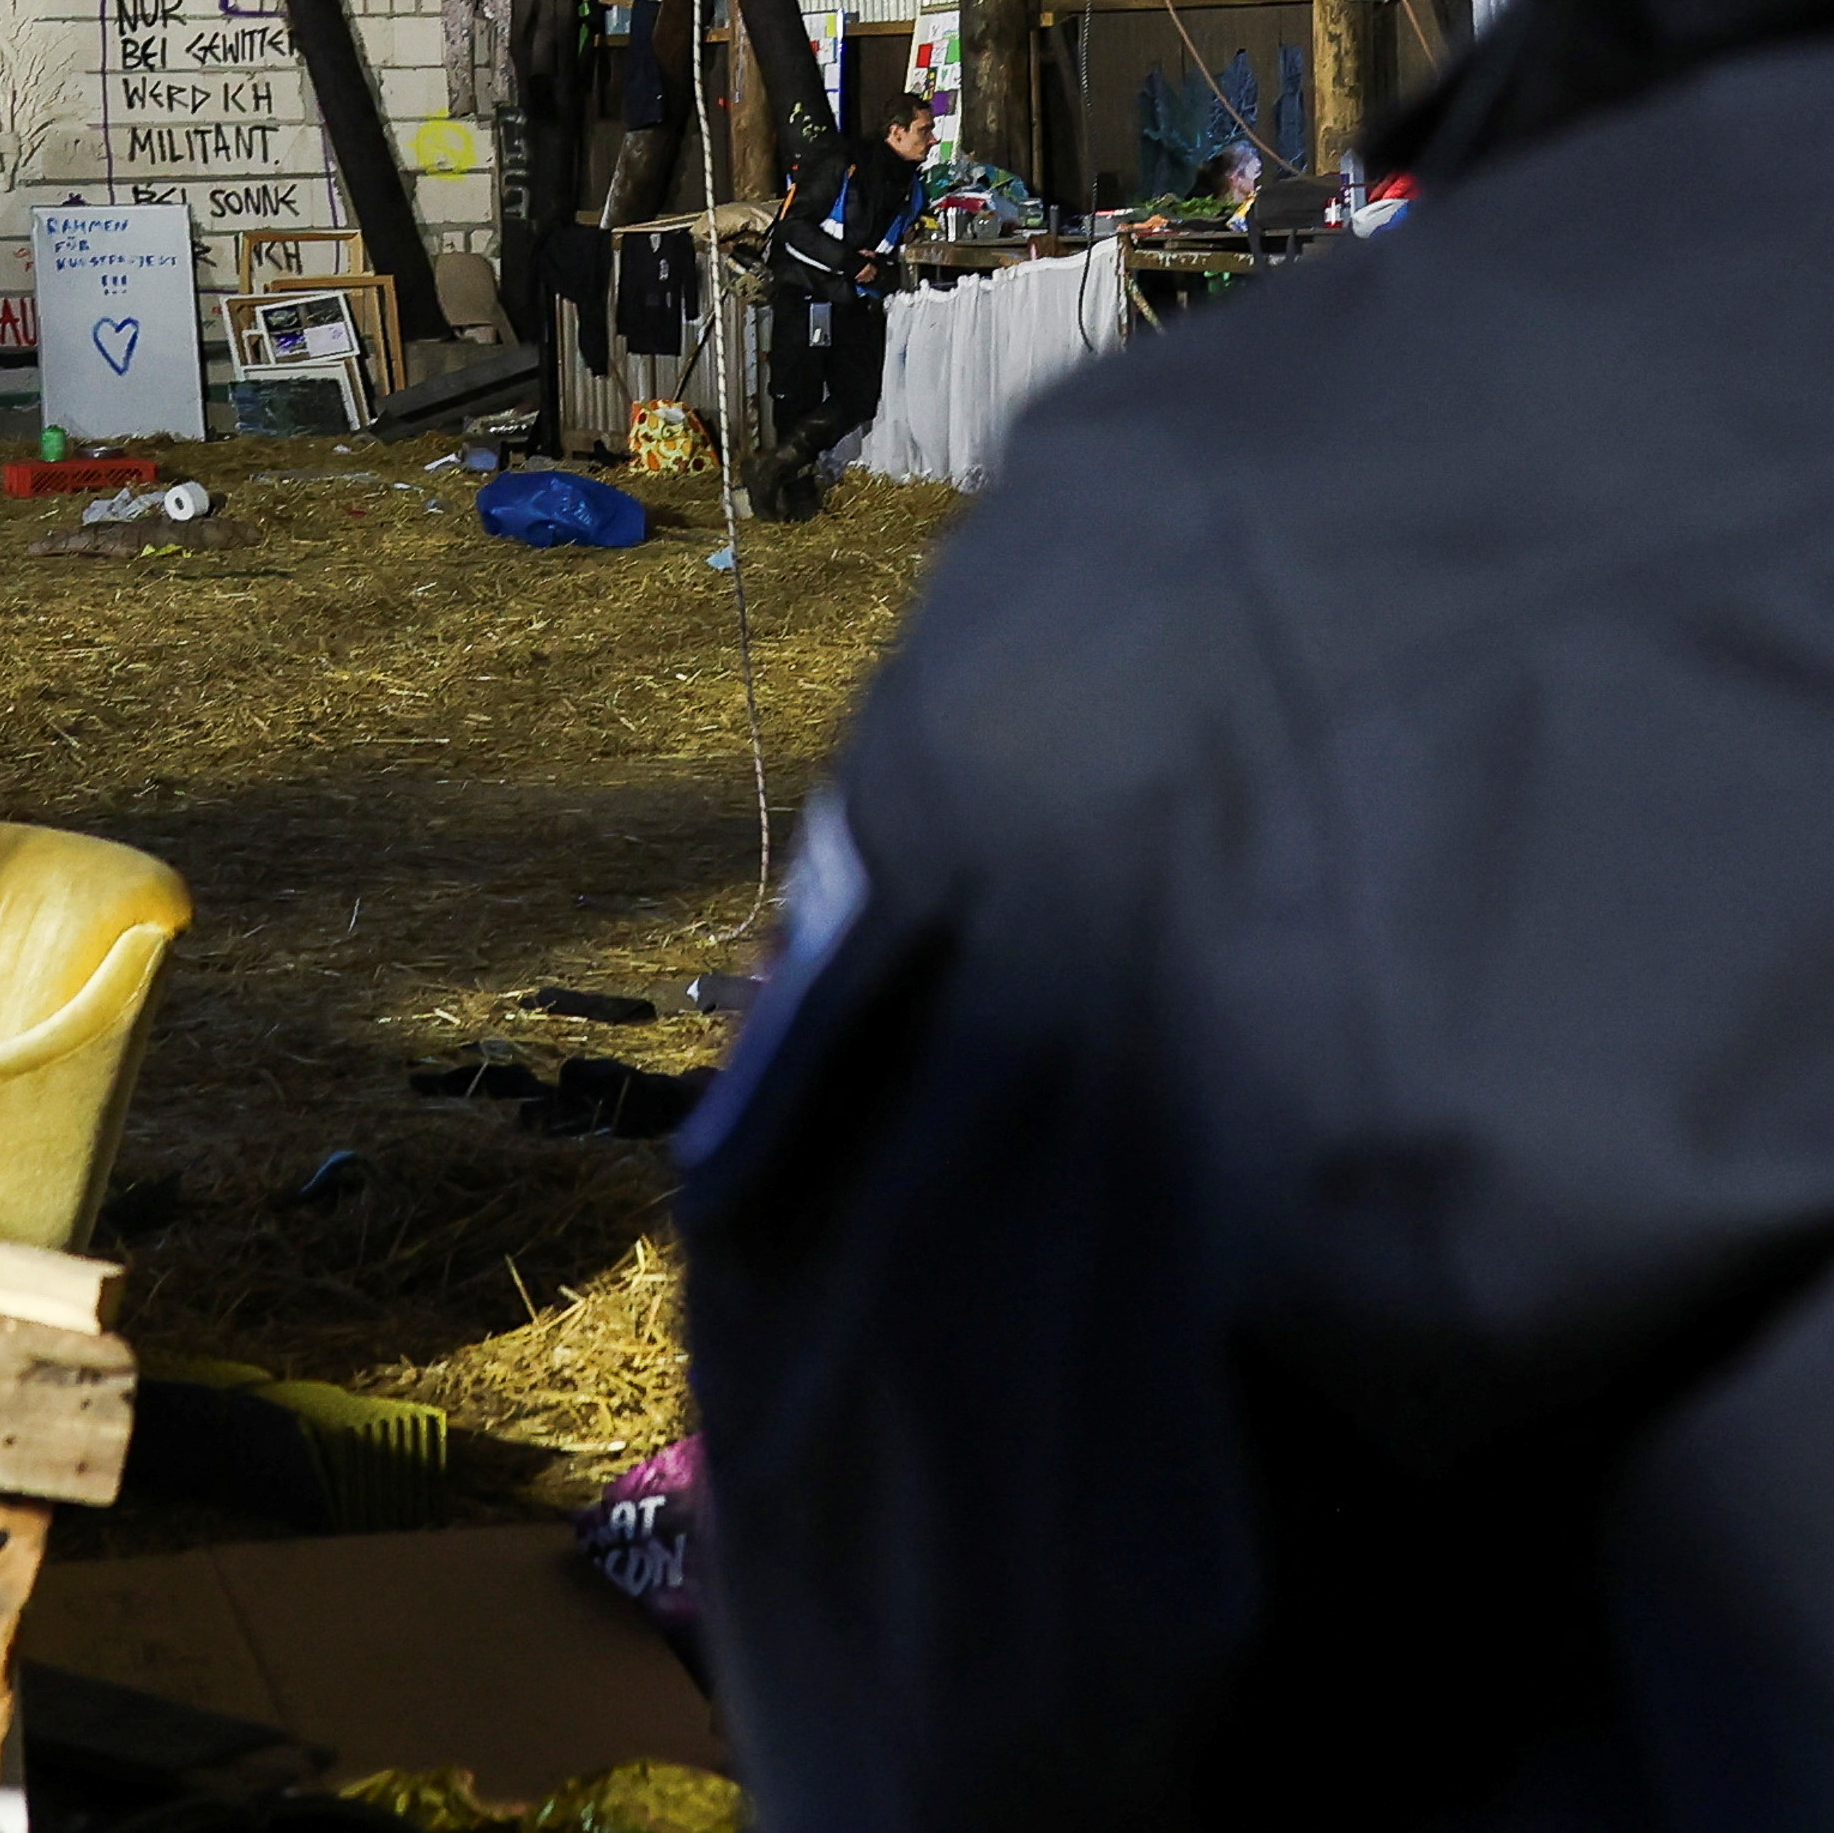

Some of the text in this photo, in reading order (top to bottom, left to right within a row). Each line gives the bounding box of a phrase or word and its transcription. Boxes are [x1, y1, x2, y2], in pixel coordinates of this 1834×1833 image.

[121, 36, 167, 72] BEI
[123, 76, 273, 114] WERD ICH
[128, 123, 280, 165] MILITANT.
[209, 184, 300, 217] SONNE
